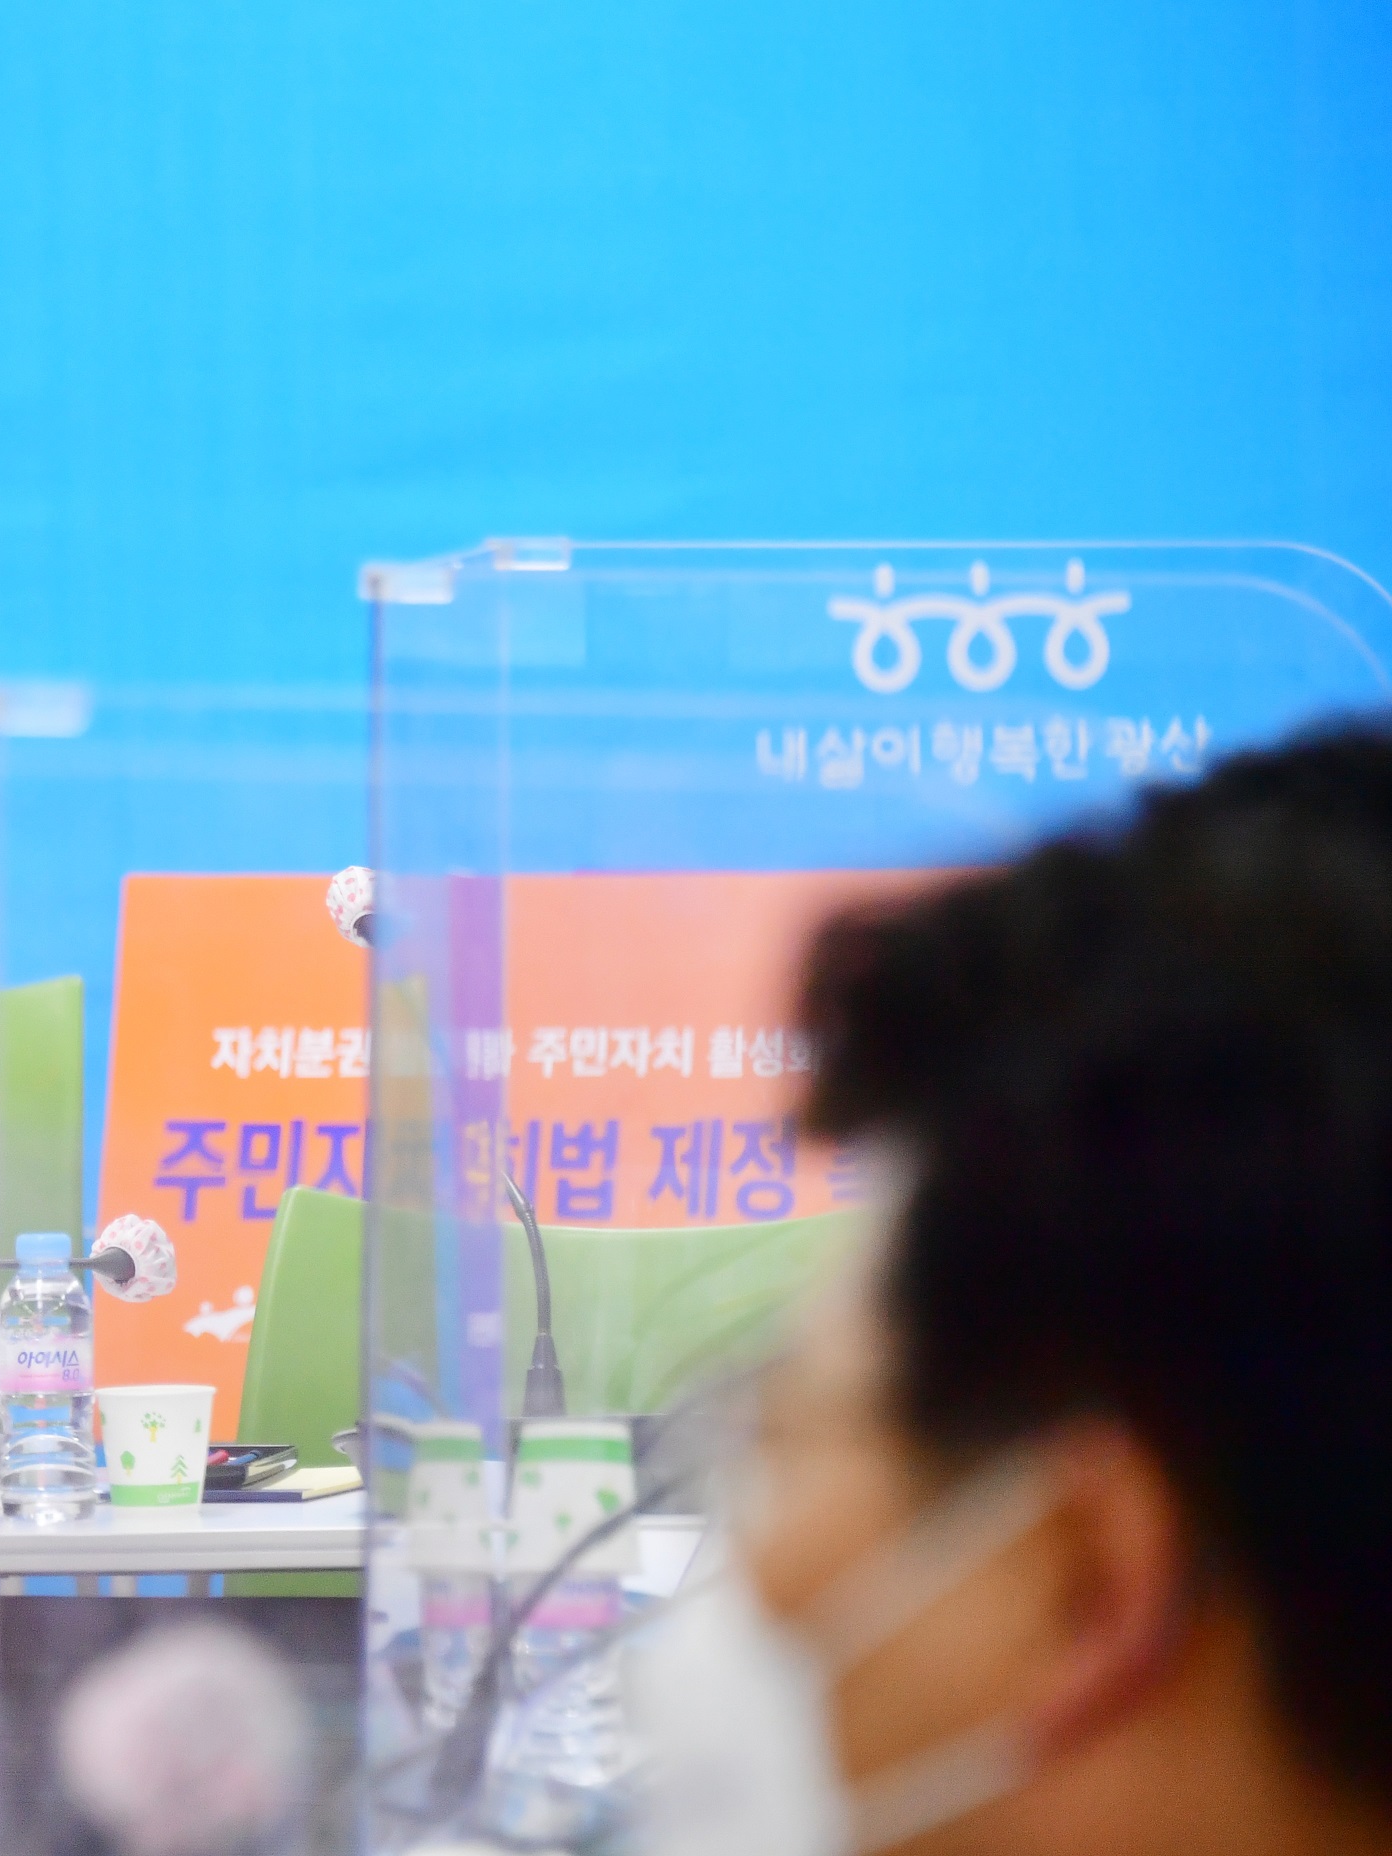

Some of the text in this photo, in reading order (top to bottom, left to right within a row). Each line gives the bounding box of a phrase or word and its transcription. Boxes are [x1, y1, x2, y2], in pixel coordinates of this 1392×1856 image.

[211, 1028, 372, 1079] 자치분권
[526, 1027, 694, 1078] 주민자치
[648, 1117, 797, 1221] 제정
[17, 1350, 79, 1368] 아이시스
